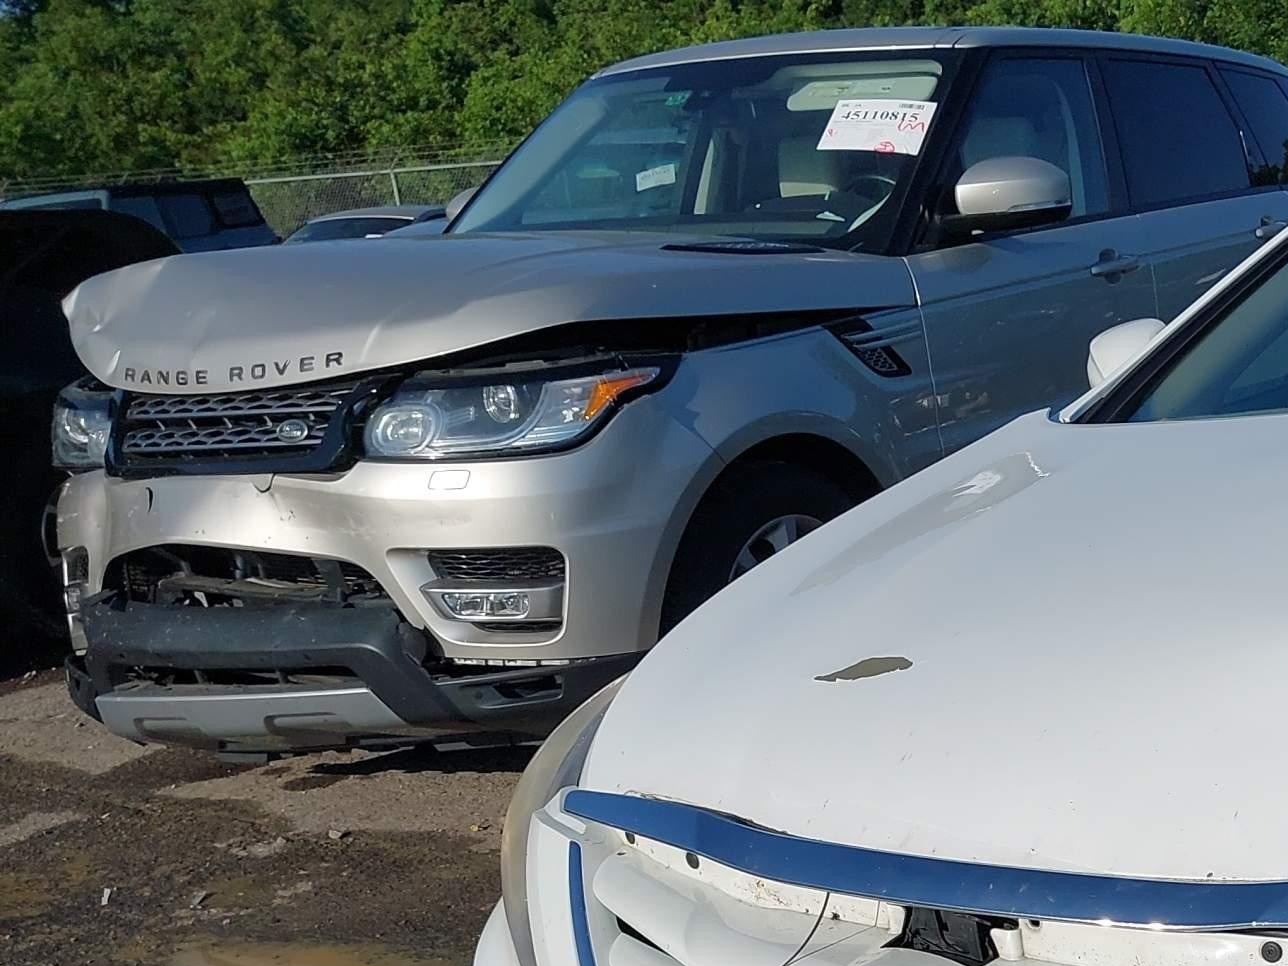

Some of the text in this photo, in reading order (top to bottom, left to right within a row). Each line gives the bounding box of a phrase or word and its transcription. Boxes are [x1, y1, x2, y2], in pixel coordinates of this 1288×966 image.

[841, 110, 920, 123] 45110815
[124, 351, 344, 386] RANGE ROVER
